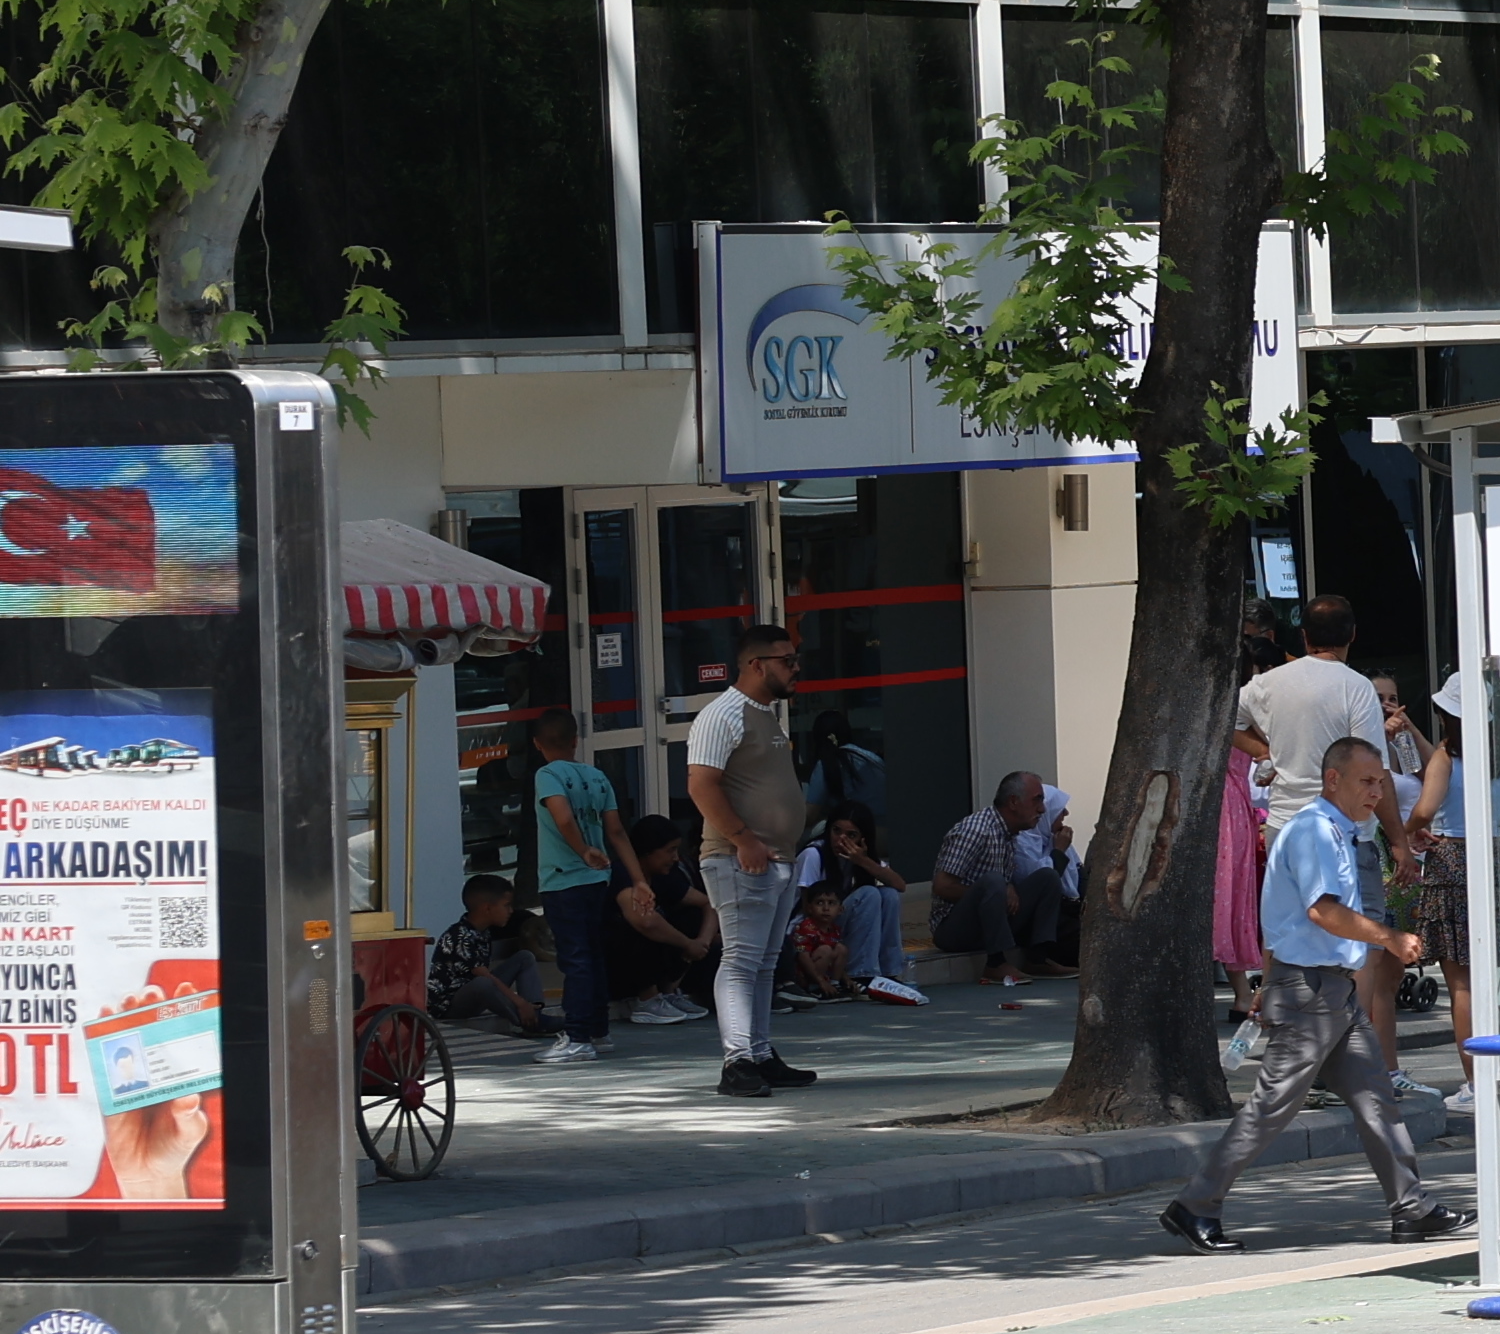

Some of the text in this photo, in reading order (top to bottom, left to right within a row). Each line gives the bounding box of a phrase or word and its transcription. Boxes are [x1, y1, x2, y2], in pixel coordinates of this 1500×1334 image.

[763, 335, 847, 404] SGK
[293, 415, 299, 427] 7
[32, 797, 206, 812] NE KADAR BAKİYEM KALDI
[32, 816, 131, 832] DİYE DÜŞÜNME
[3, 839, 208, 885] ARKADAŞIM!
[24, 909, 51, 923] GİBİ
[22, 926, 75, 941] KART
[16, 944, 75, 960] BAŞLADI
[18, 997, 76, 1029] BİNİŞ
[25, 1033, 78, 1095] TL
